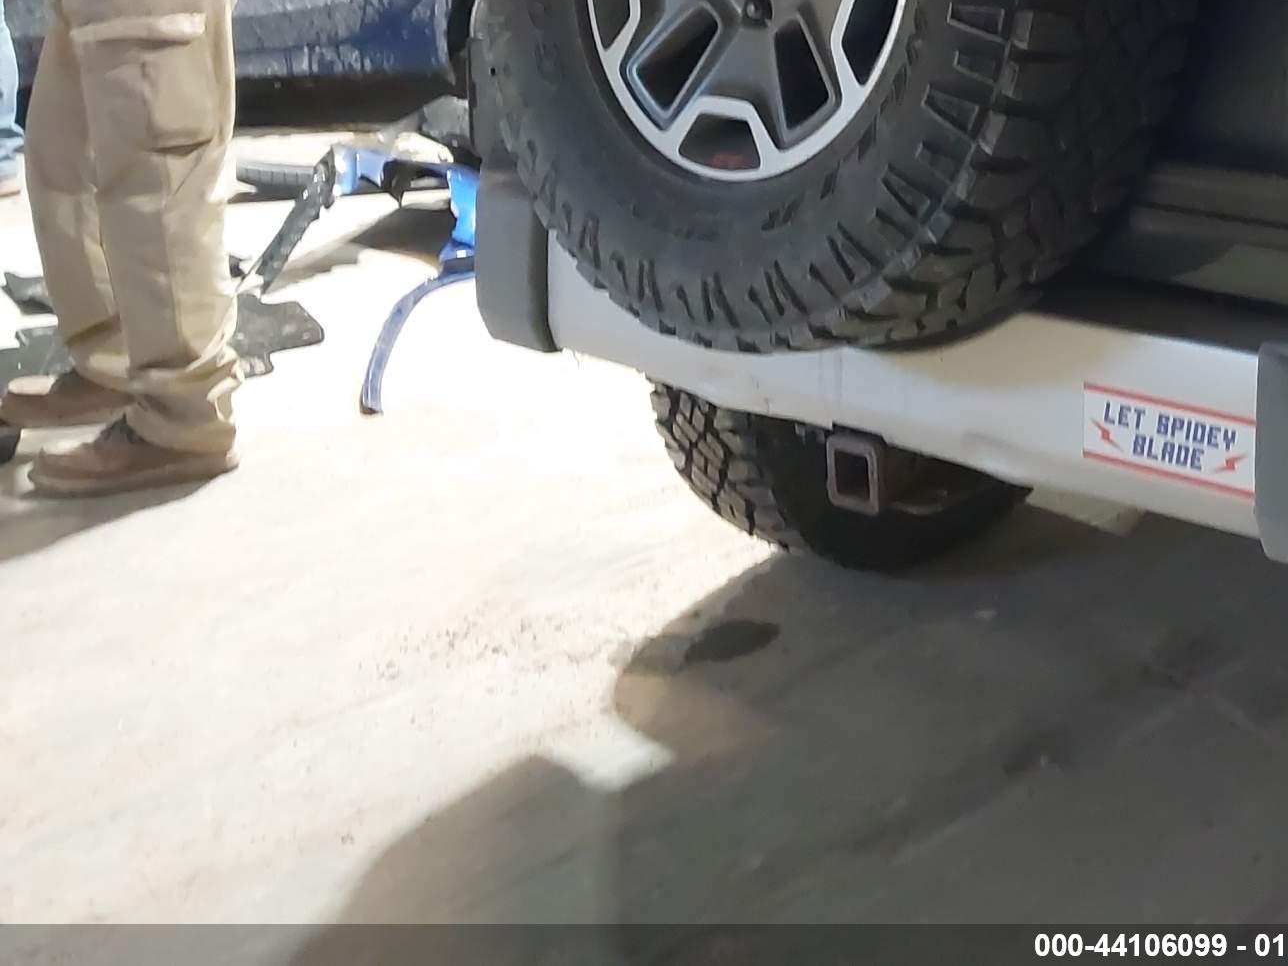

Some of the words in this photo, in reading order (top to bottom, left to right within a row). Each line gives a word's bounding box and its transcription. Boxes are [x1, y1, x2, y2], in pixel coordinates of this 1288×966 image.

[1104, 400, 1146, 430] LET
[1156, 412, 1237, 451] SPIDEY
[1132, 434, 1205, 470] BLADE
